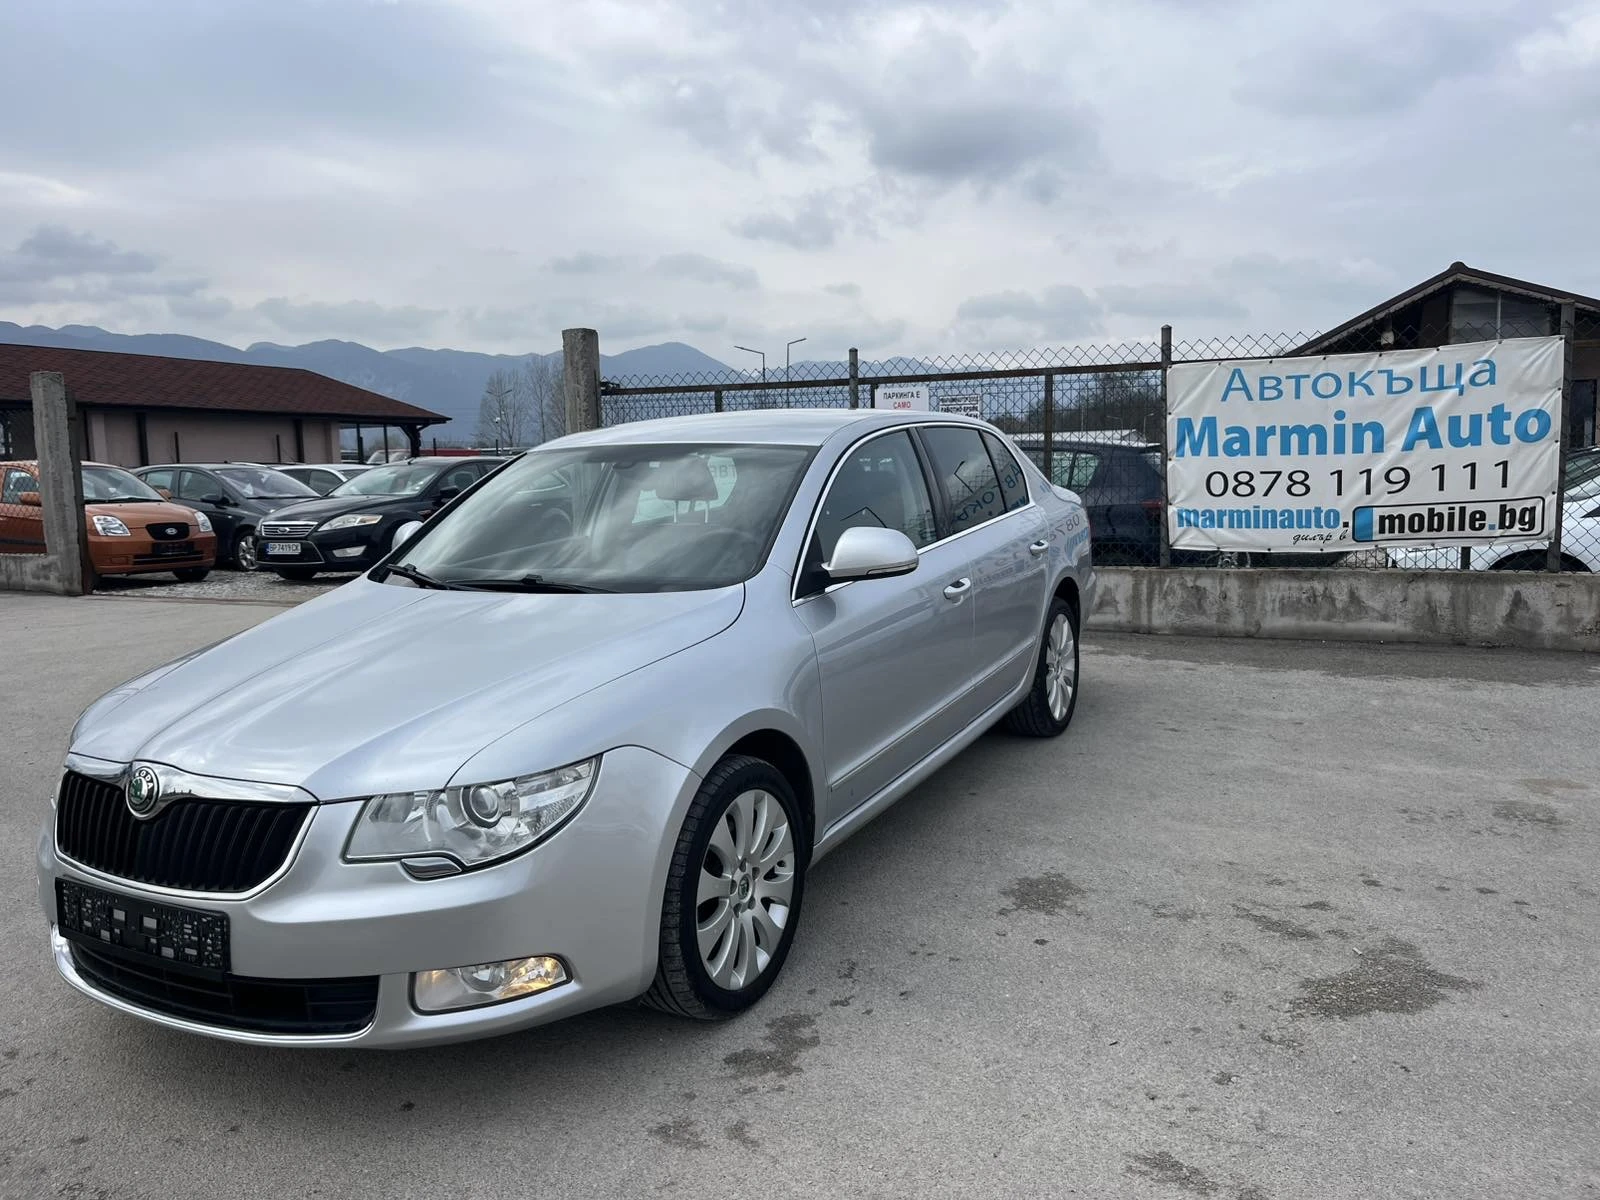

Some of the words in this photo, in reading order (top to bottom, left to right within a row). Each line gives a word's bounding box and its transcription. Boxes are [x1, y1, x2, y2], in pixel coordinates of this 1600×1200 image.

[883, 391, 914, 400] ПАРКИНГА
[892, 401, 911, 409] САМО
[1175, 409, 1385, 459] Marmin
[1401, 403, 1552, 453] Auto
[1205, 469, 1311, 498] 0878
[1329, 466, 1411, 497] 119
[1431, 459, 1509, 491] 111
[1378, 502, 1537, 535] mobile.bg
[1292, 532, 1333, 545] дилър
